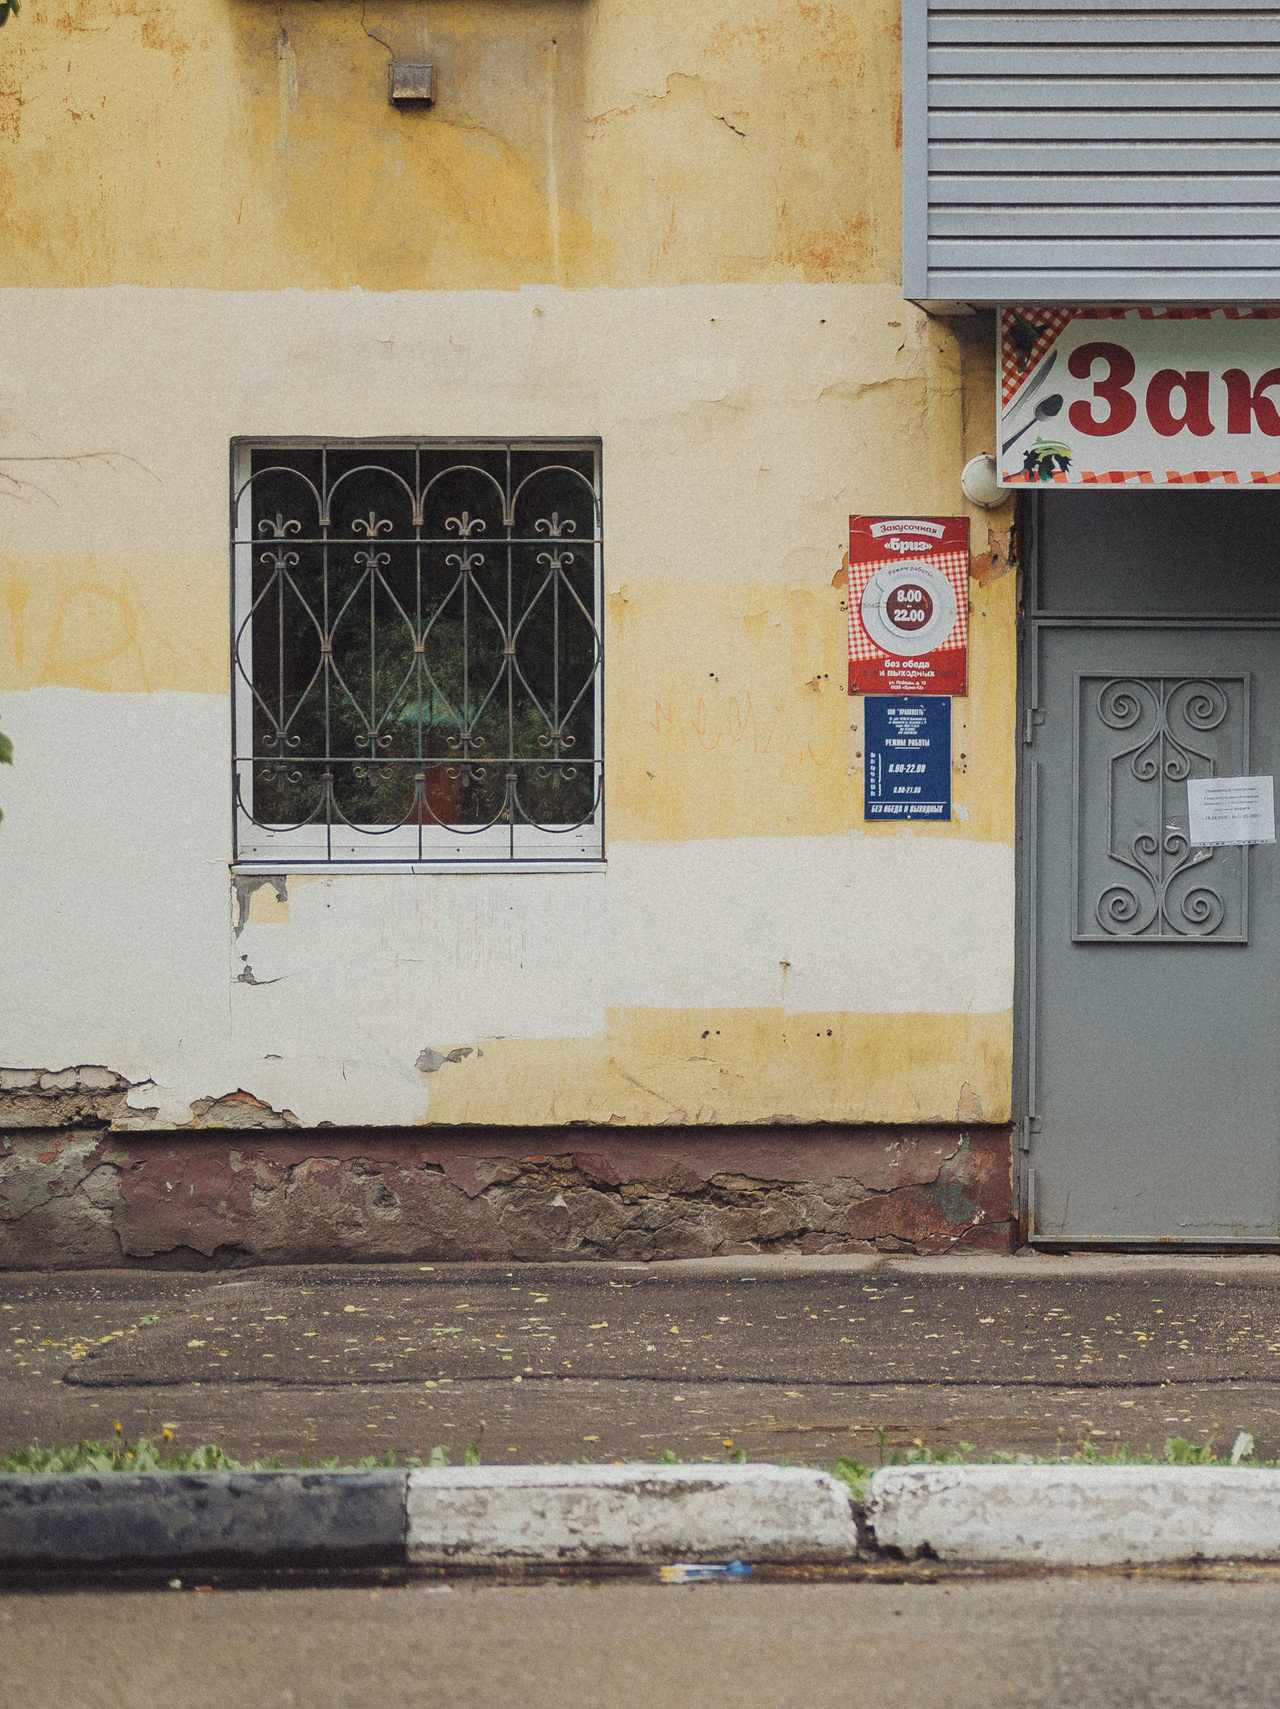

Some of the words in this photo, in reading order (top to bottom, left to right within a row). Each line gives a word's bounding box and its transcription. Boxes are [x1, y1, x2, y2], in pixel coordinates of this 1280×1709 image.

[879, 524, 938, 534] Закусочная
[883, 537, 933, 554] «Бриз»
[887, 566, 909, 576] Режим
[896, 589, 922, 603] 8.00
[893, 609, 925, 622] 22.00
[884, 659, 901, 668] без
[902, 659, 930, 669] обеда
[887, 670, 936, 678] выходных
[885, 739, 907, 747] РЕЖИМ
[907, 739, 931, 747] РАБОТЫ
[871, 805, 883, 813] БЕЗ
[883, 805, 902, 814] ОБЕДА
[909, 805, 944, 814] ВЫХОДНЫХ
